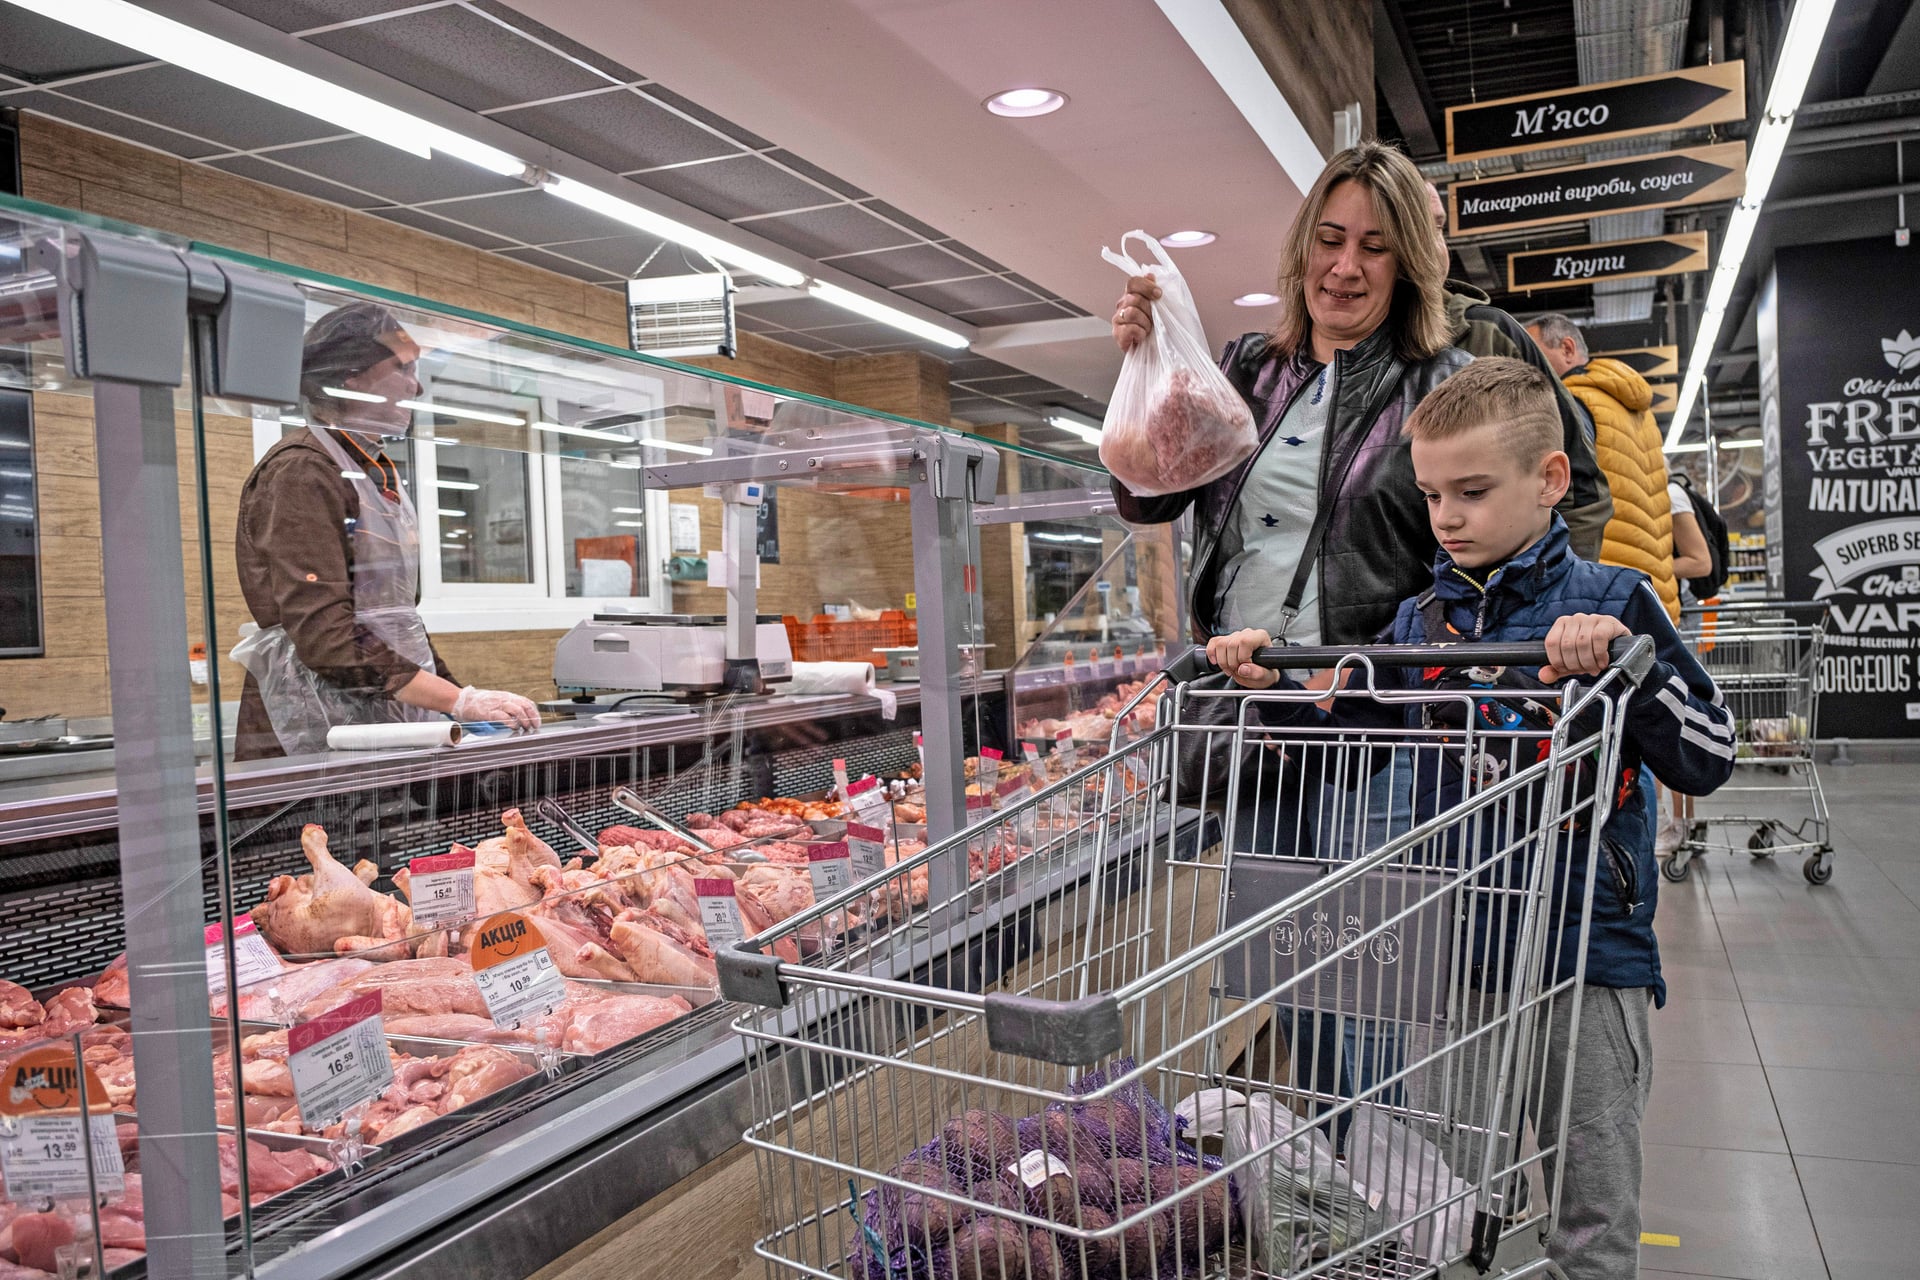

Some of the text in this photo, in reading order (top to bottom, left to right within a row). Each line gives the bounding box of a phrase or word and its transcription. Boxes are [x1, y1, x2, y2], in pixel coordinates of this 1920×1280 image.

[1511, 103, 1609, 137] М’ясо
[1461, 171, 1694, 216] Макаронні вироби, соуси
[1553, 255, 1625, 280] Крупи
[1804, 396, 1920, 446] FRE
[1836, 533, 1899, 565] SUPERB
[1862, 574, 1920, 598] Chee
[1830, 602, 1920, 633] VAR
[1859, 636, 1908, 648] SELECTION
[480, 919, 527, 949] АКЦІЯ
